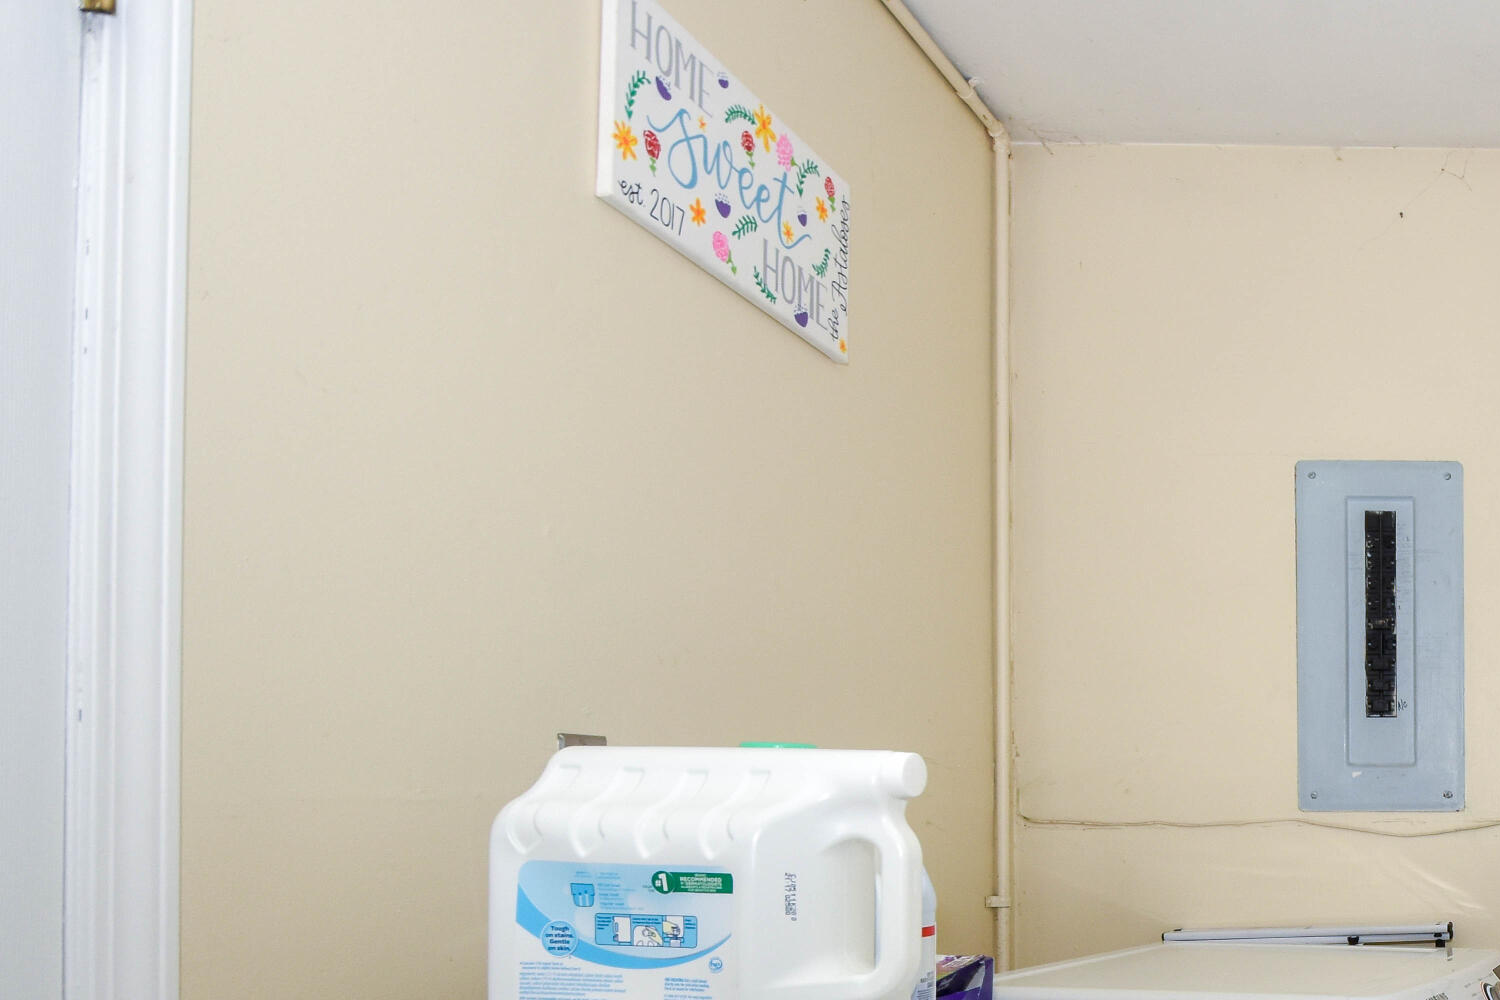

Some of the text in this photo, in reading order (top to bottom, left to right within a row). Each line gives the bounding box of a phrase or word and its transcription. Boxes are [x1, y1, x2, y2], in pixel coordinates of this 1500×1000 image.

[630, 1, 714, 118] HOME
[646, 107, 812, 250] Sweet
[649, 188, 685, 236] 2017
[763, 238, 828, 331] HOME
[827, 307, 840, 342] the
[550, 925, 570, 933] Tough
